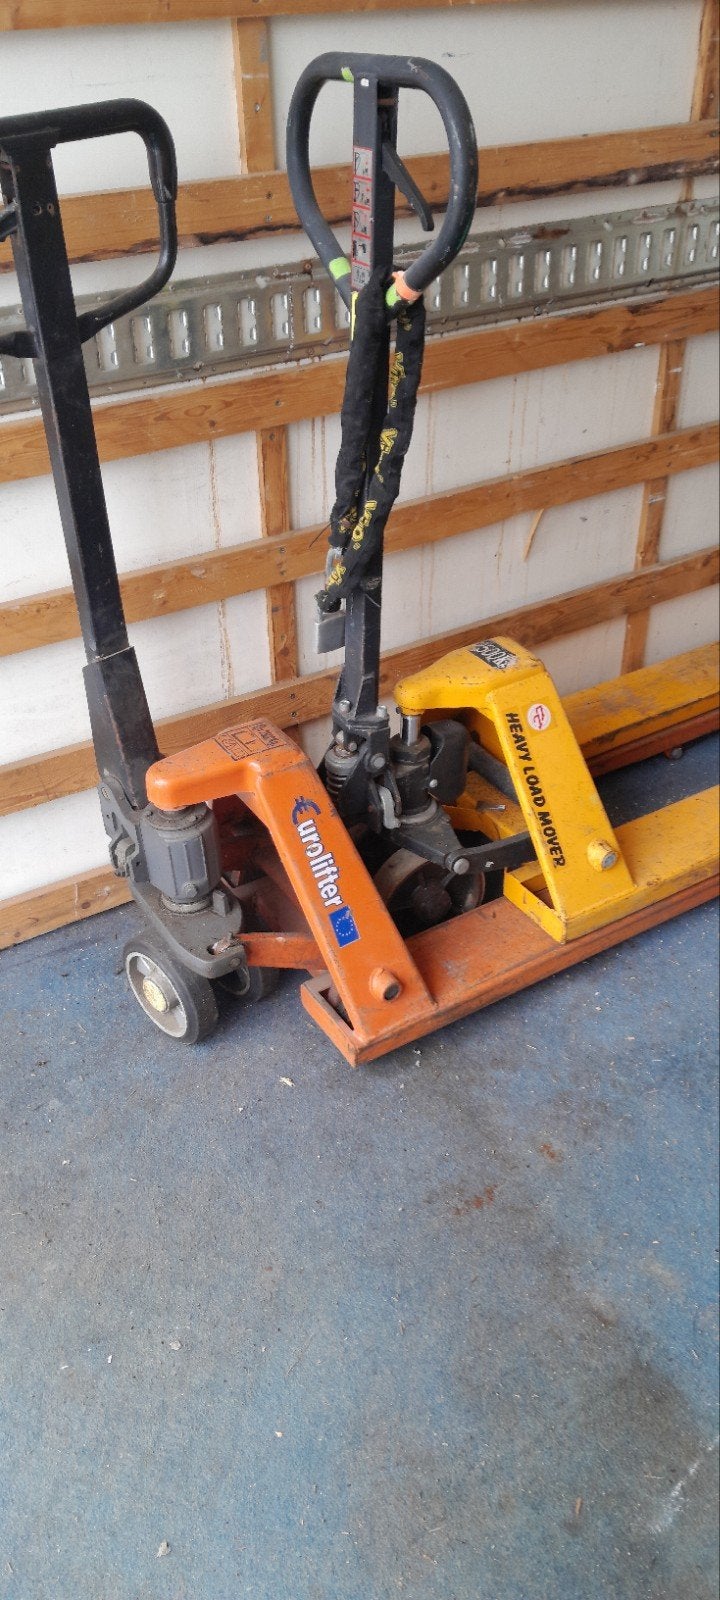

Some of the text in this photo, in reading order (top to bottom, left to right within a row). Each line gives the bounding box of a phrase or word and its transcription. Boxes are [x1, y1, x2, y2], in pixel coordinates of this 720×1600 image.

[506, 712, 567, 869] HEAVY LOAD MOVER
